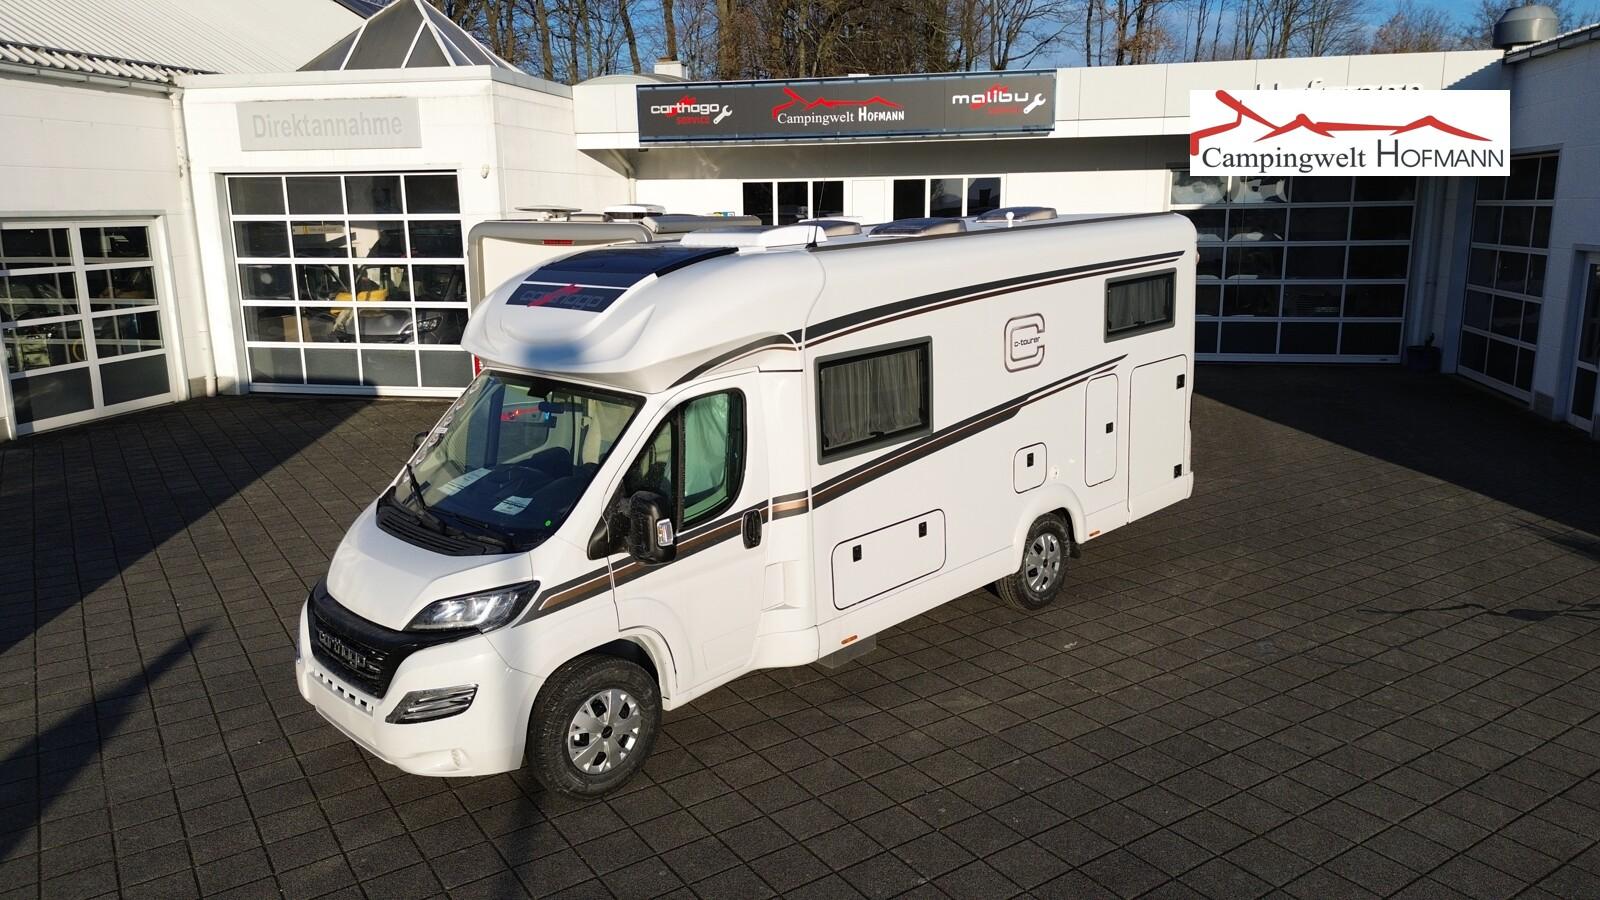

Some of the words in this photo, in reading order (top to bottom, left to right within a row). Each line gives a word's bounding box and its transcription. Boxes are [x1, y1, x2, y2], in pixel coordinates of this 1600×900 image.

[952, 89, 1029, 104] malibu
[650, 102, 720, 115] carthago
[777, 110, 854, 126] Campingwelt
[858, 106, 905, 122] HOFMANN
[252, 112, 403, 138] Direktannahme
